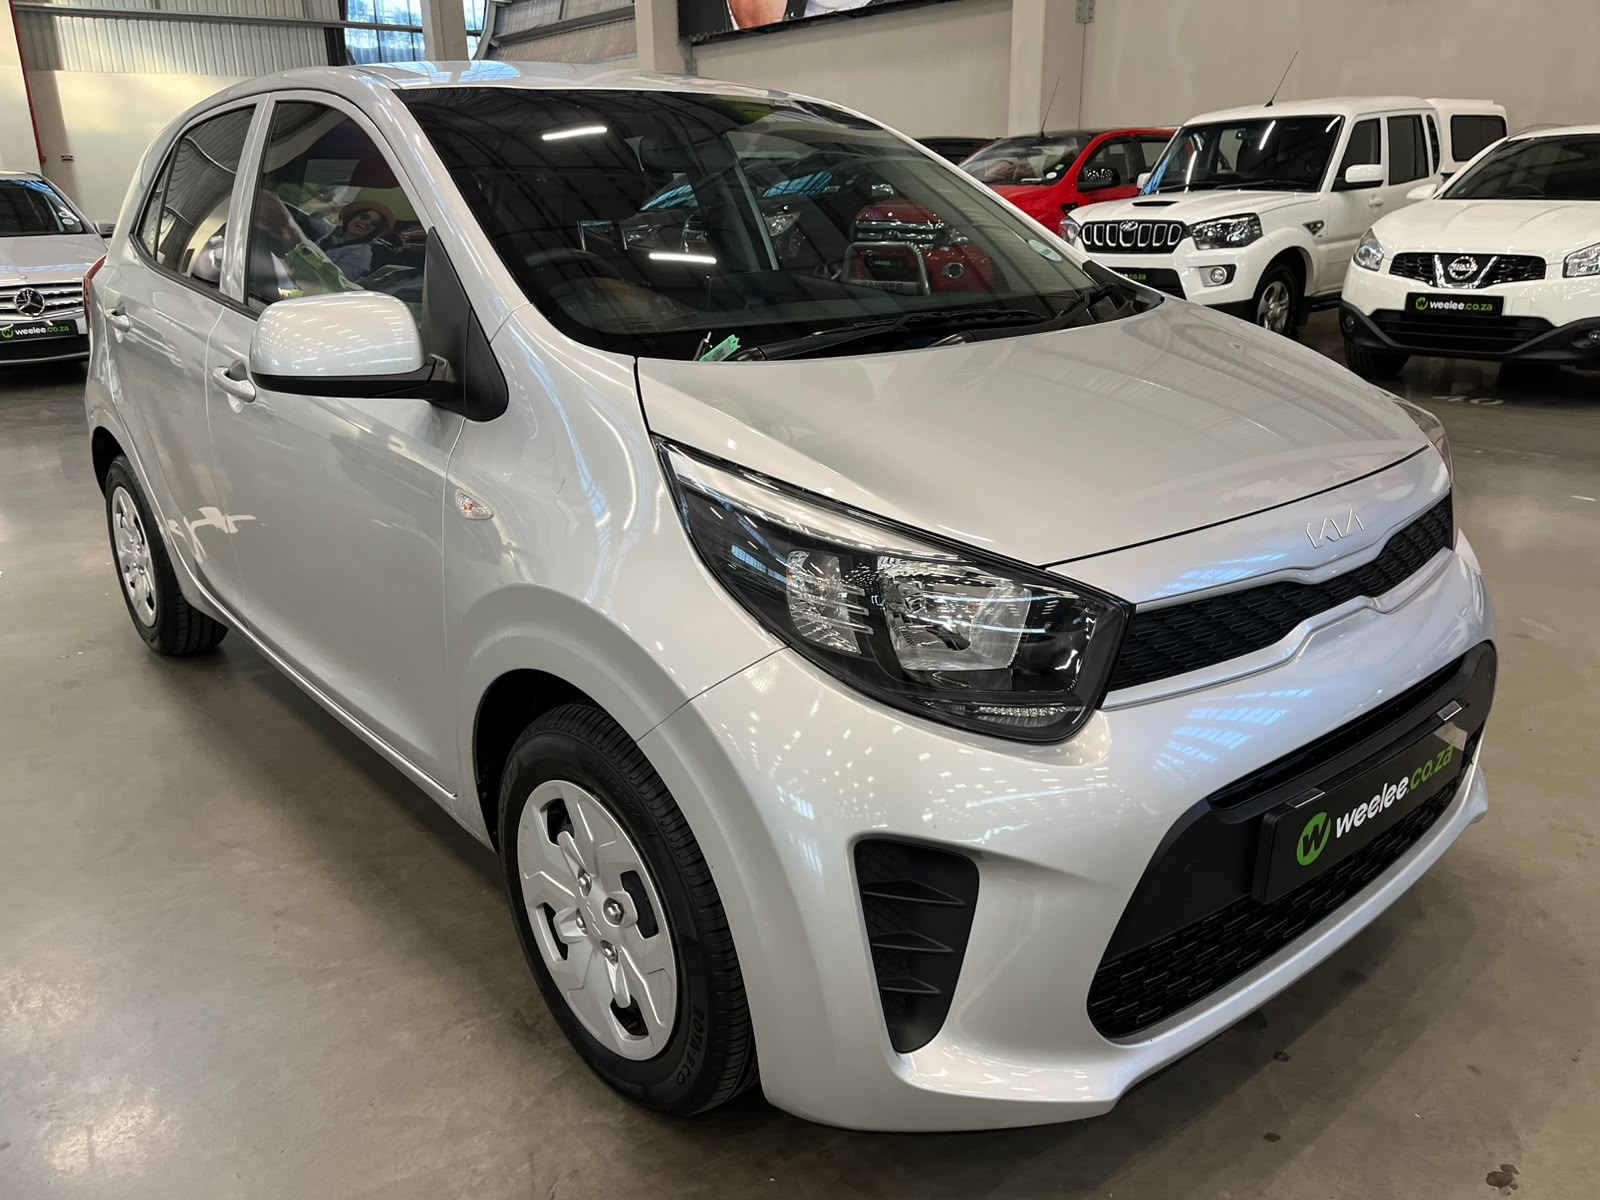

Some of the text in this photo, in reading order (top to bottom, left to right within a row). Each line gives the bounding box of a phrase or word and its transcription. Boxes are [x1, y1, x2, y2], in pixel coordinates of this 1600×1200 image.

[1430, 300, 1493, 311] weelee.co.za
[15, 326, 70, 335] weelee.co.za
[1335, 744, 1454, 839] weelee.co.za
